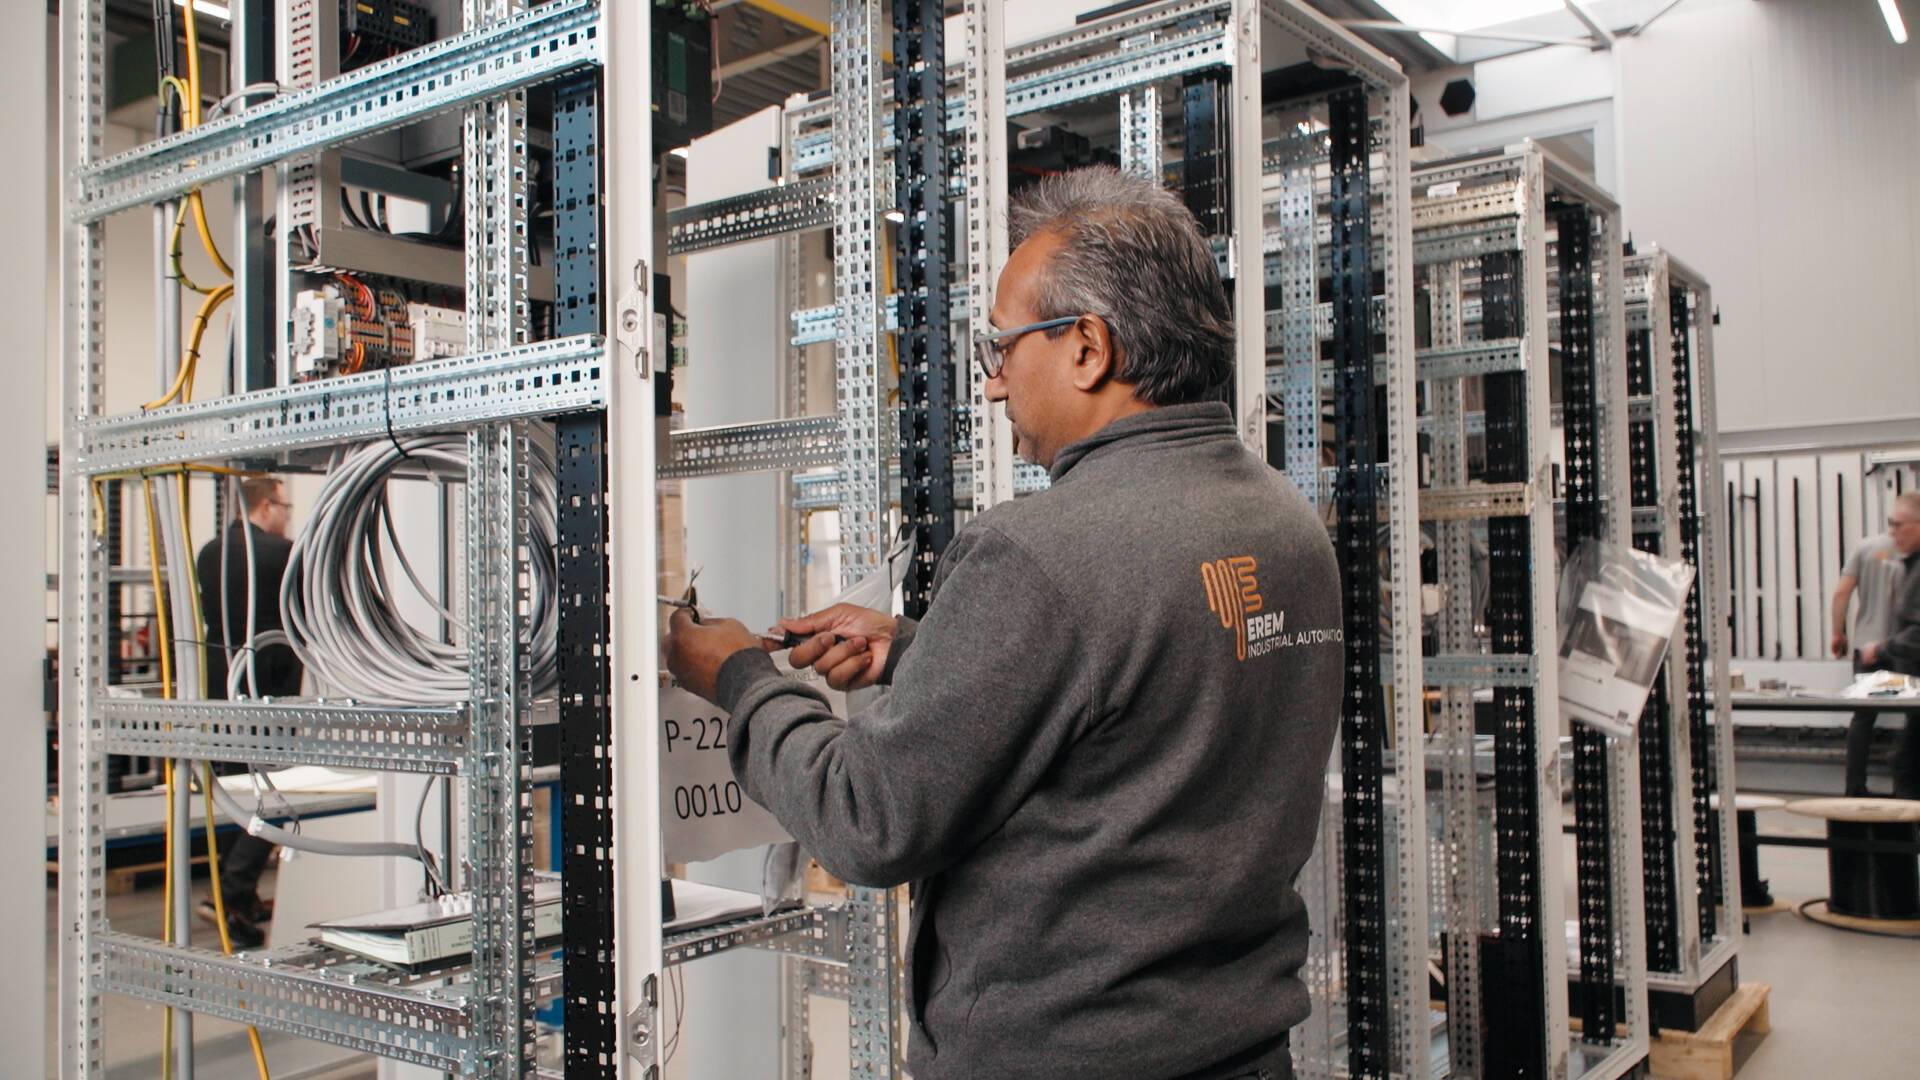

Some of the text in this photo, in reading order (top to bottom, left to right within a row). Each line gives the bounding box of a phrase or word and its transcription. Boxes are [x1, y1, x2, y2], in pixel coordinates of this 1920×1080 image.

[1247, 610, 1284, 642] EREM
[1247, 628, 1343, 658] INDUSTRIAL AUTOMATIO
[664, 716, 732, 753] P-22
[674, 780, 742, 820] 0010
